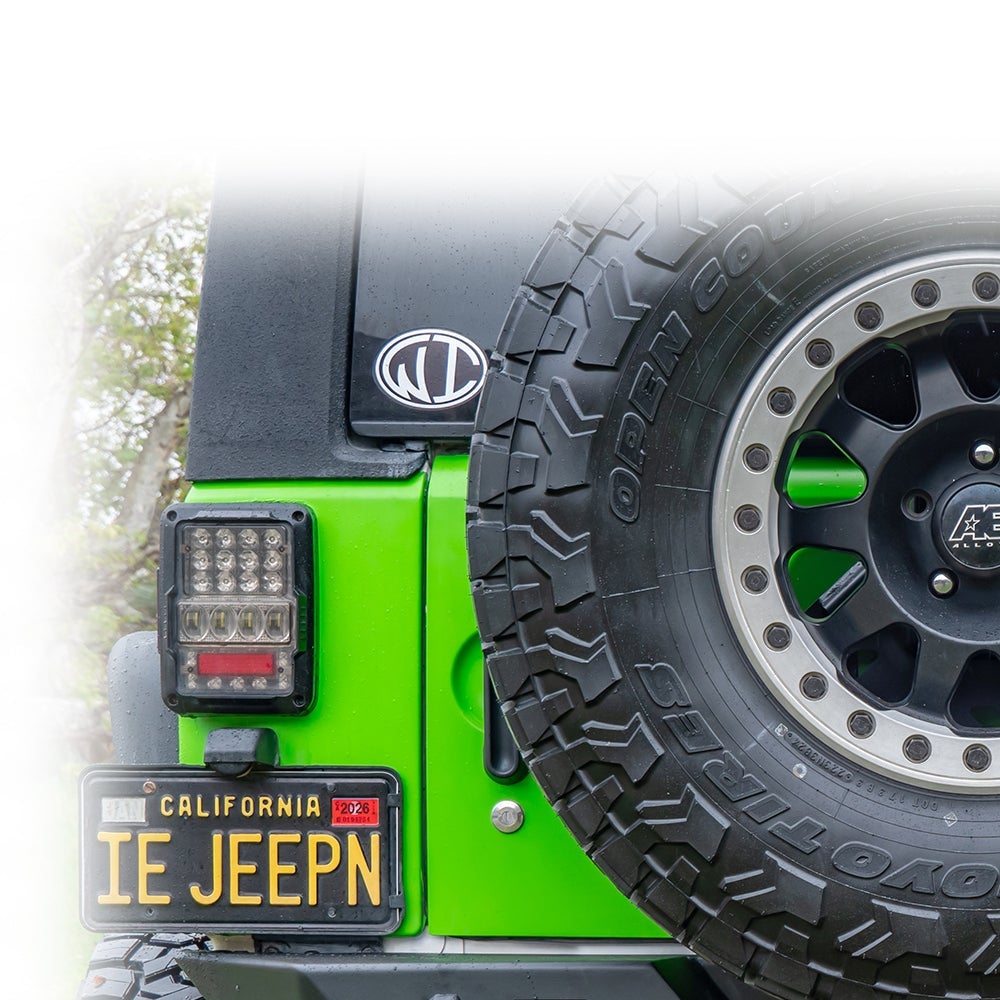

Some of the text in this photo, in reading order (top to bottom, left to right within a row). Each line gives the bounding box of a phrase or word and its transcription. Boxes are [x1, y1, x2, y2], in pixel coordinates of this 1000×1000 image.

[609, 310, 693, 523] OPEN
[634, 662, 827, 855] TIRES
[160, 795, 321, 818] CALIFORNIA
[340, 802, 370, 815] 2026
[97, 831, 381, 906] IE JEEPN
